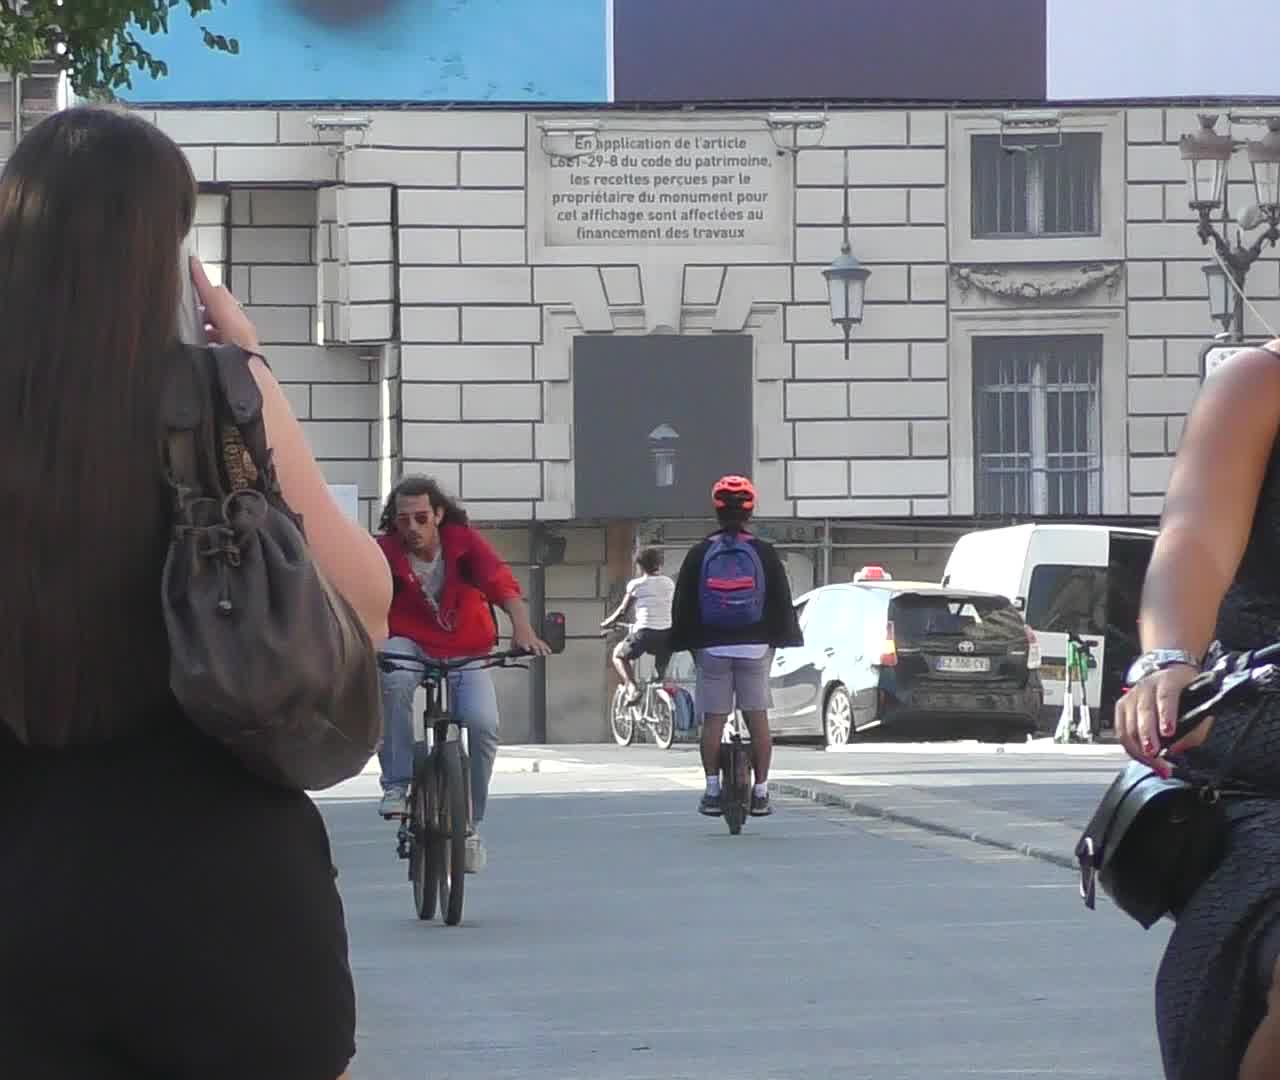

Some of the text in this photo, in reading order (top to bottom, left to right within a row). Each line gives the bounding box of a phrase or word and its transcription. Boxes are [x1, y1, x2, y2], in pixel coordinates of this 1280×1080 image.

[575, 137, 746, 152] En application de l'article
[621, 154, 637, 168] du
[641, 154, 671, 168] code
[675, 154, 692, 168] du
[695, 154, 772, 170] patrimoine,
[570, 172, 751, 187] les recettes perçues par le
[552, 191, 768, 205] propriétaire du monument pour
[557, 208, 764, 224] cet affichage sont affectées au
[576, 227, 745, 239] financement des travaux
